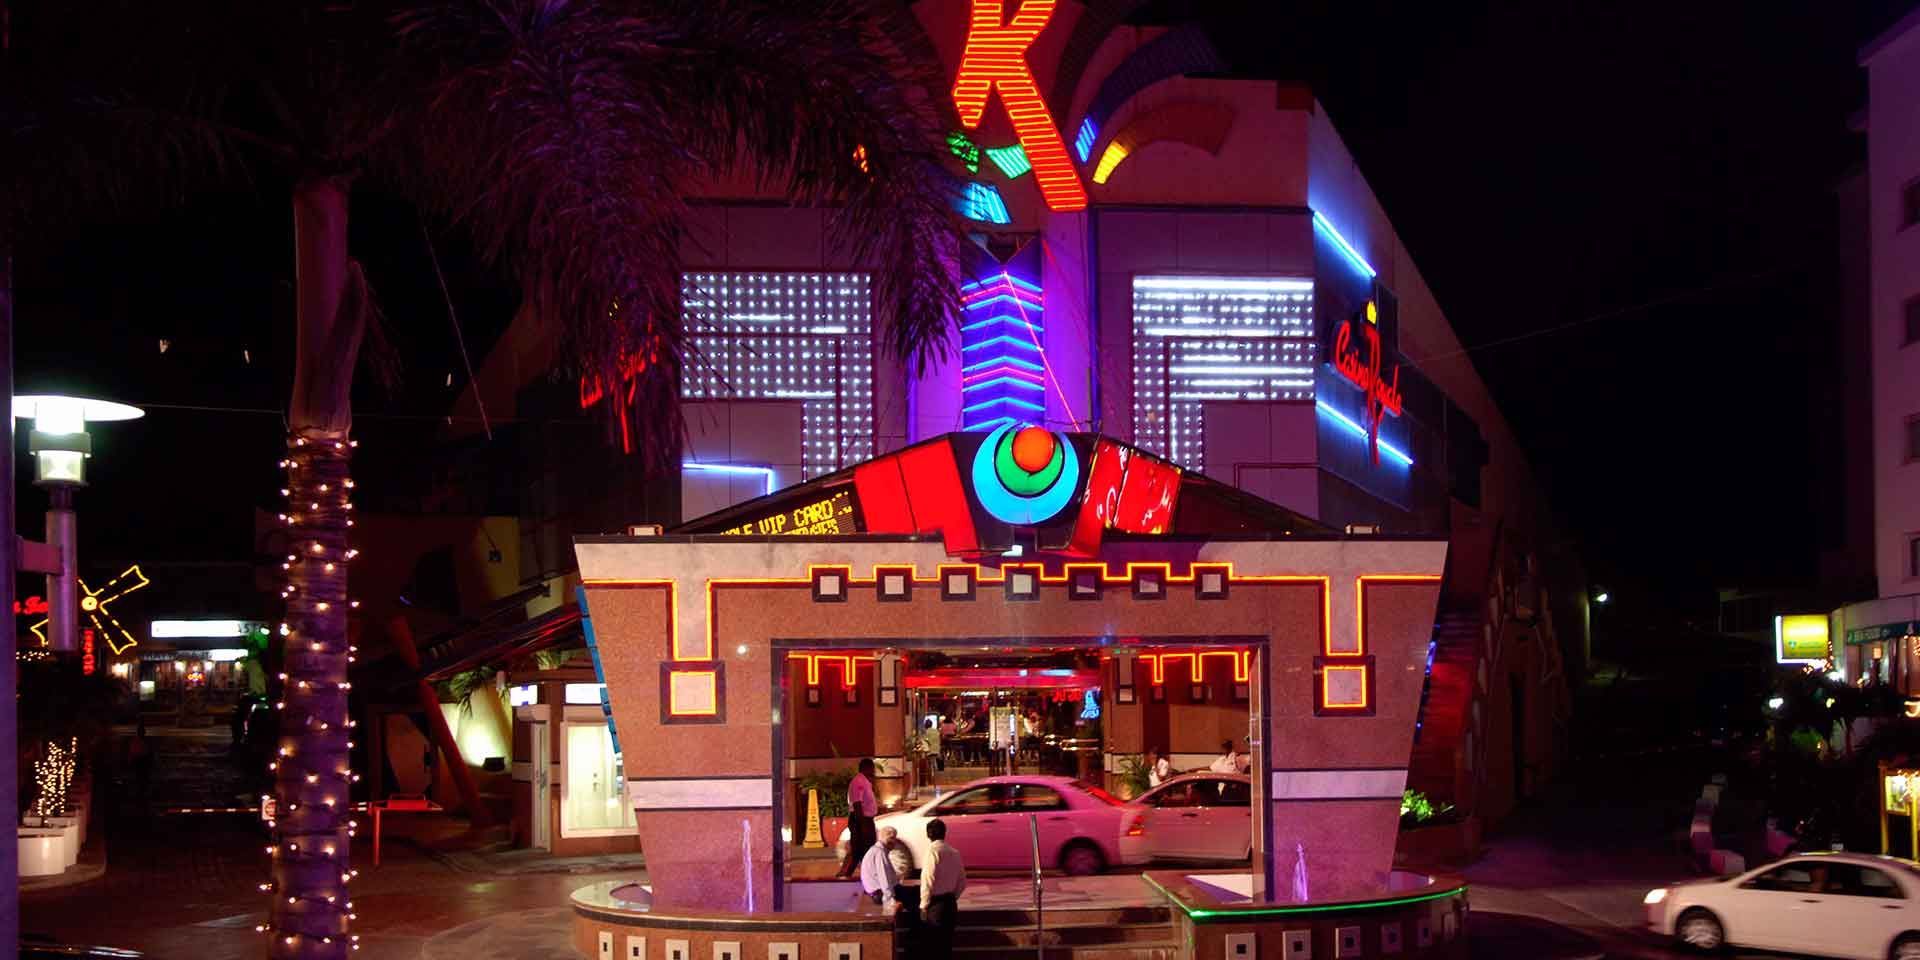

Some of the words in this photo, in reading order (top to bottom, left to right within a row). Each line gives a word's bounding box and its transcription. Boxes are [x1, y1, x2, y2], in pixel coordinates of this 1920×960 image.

[1335, 319, 1370, 391] Casino
[758, 513, 786, 535] VIP
[793, 500, 834, 528] CARD
